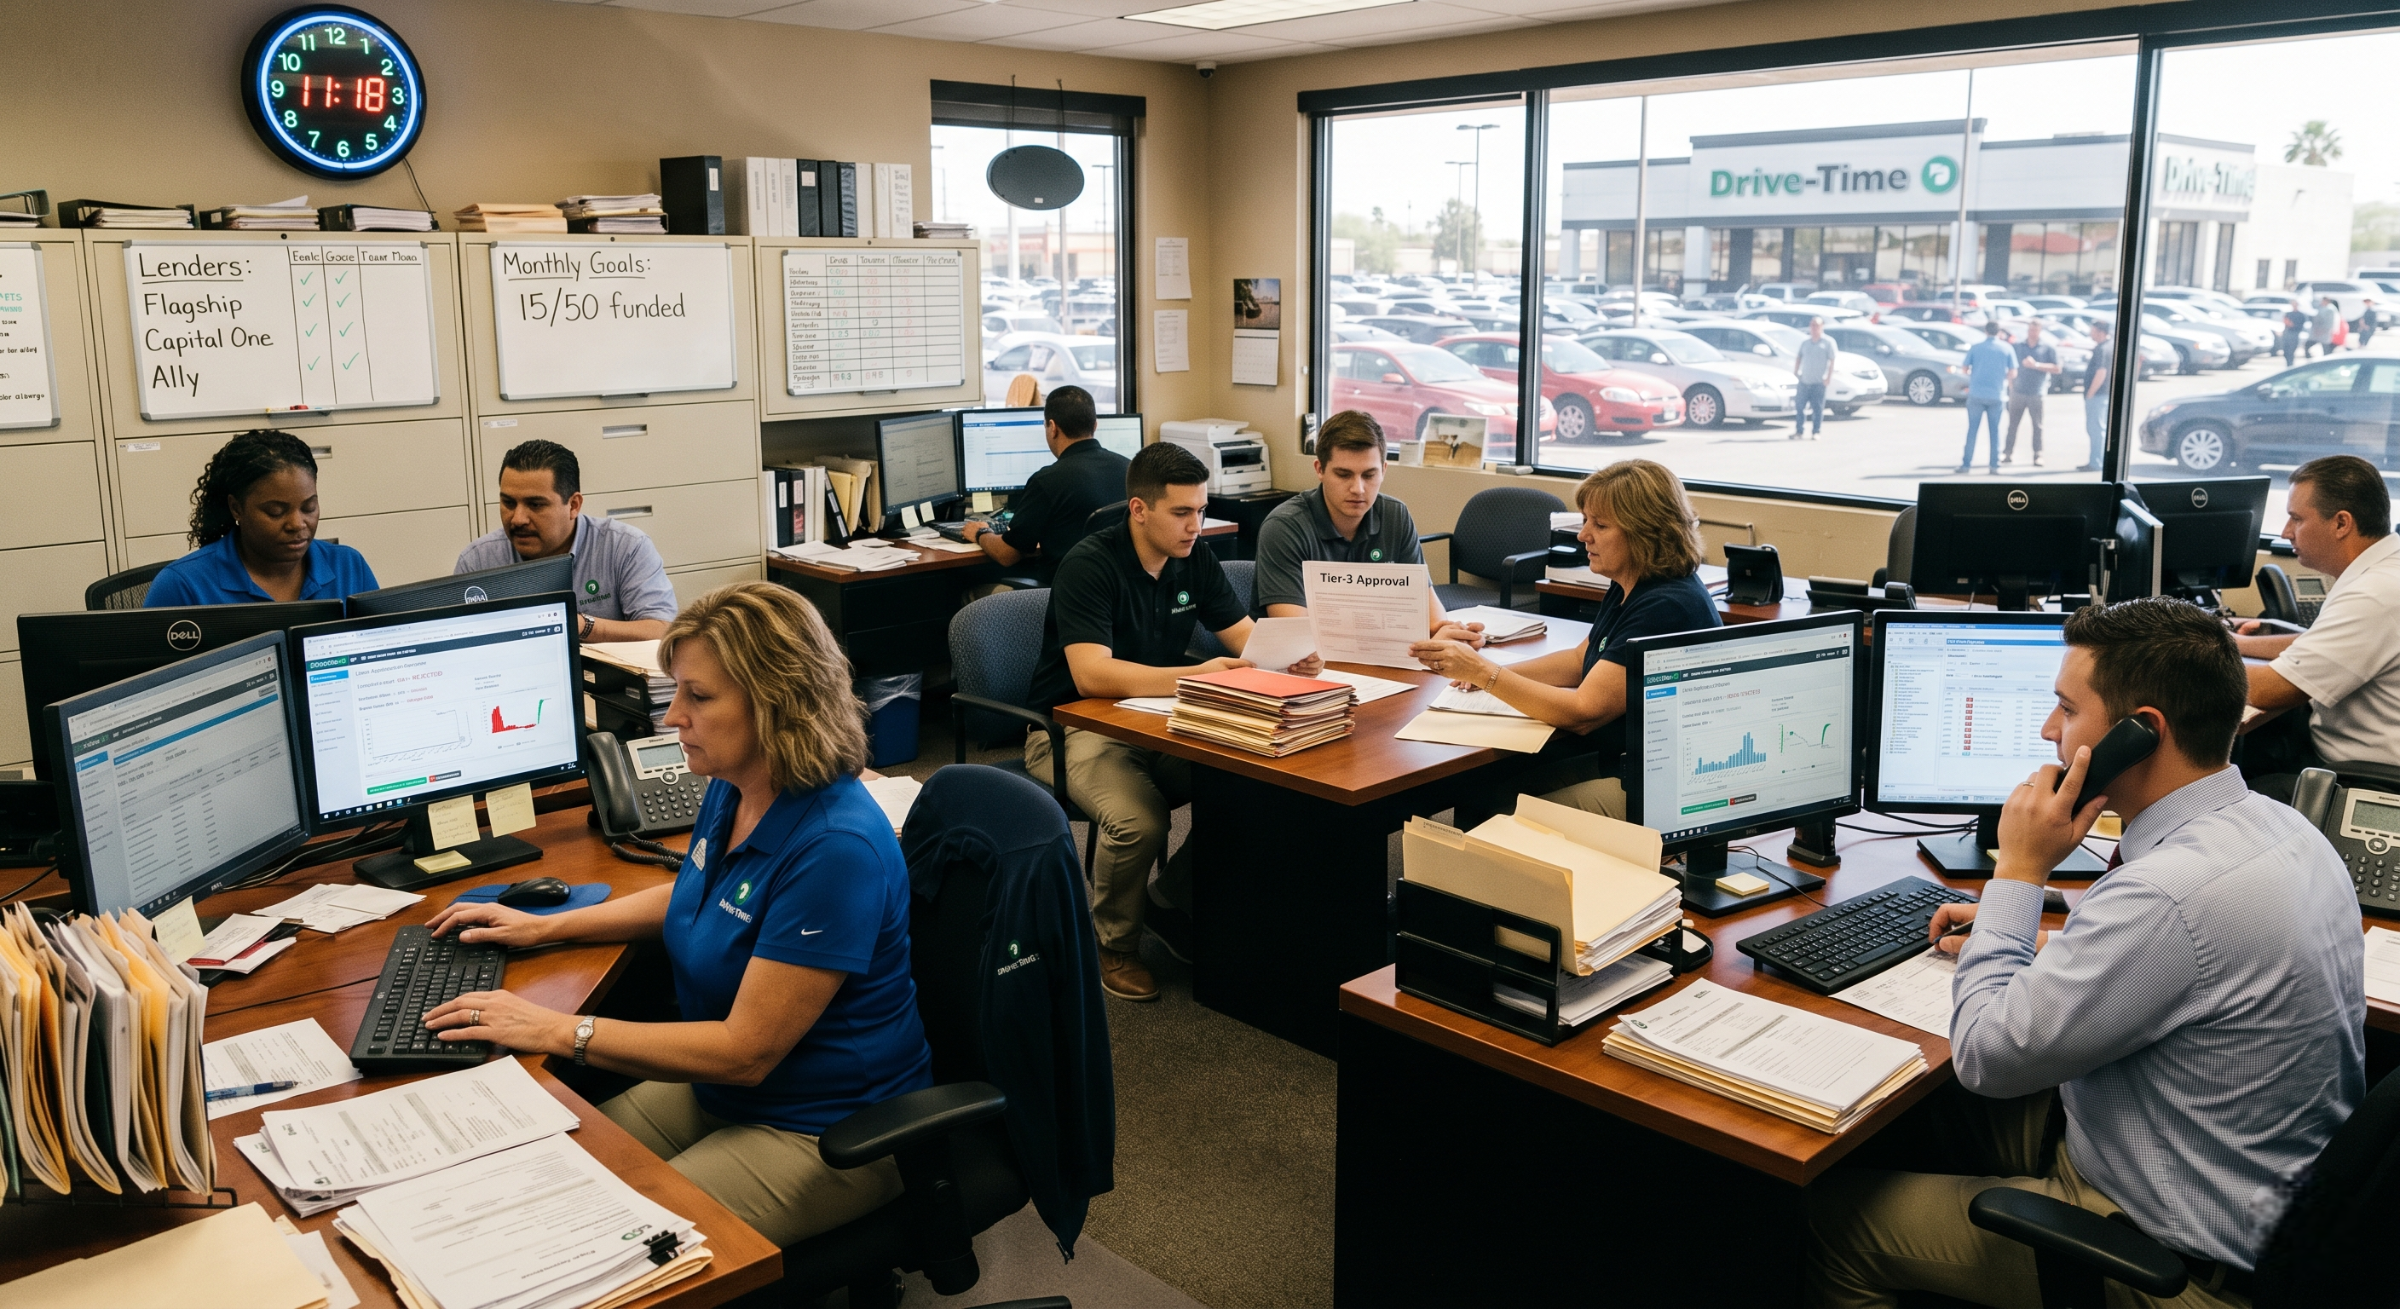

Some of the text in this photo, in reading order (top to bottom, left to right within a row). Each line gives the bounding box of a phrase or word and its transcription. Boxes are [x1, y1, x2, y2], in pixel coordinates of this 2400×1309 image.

[298, 34, 315, 51] 11
[325, 27, 346, 45] 12
[360, 38, 369, 54] 1
[278, 53, 300, 71] 10
[381, 59, 394, 76] 2
[271, 80, 284, 98] 9
[303, 76, 384, 112] 11:18
[392, 87, 404, 105] 3
[284, 110, 297, 128] 8
[384, 115, 397, 132] 4
[308, 131, 320, 148] 7
[365, 133, 378, 150] 5
[337, 141, 350, 157] 6
[1710, 163, 1908, 197] Drive-Time
[139, 252, 252, 278] Lenders:
[503, 250, 651, 282] Monthly Goals:
[144, 292, 243, 324] Flagship
[520, 287, 686, 328] 15/50 funded
[145, 325, 274, 358] Capital One
[152, 364, 200, 397] Ally
[1320, 572, 1409, 588] Tier-3 Approval
[170, 631, 199, 640] DELL
